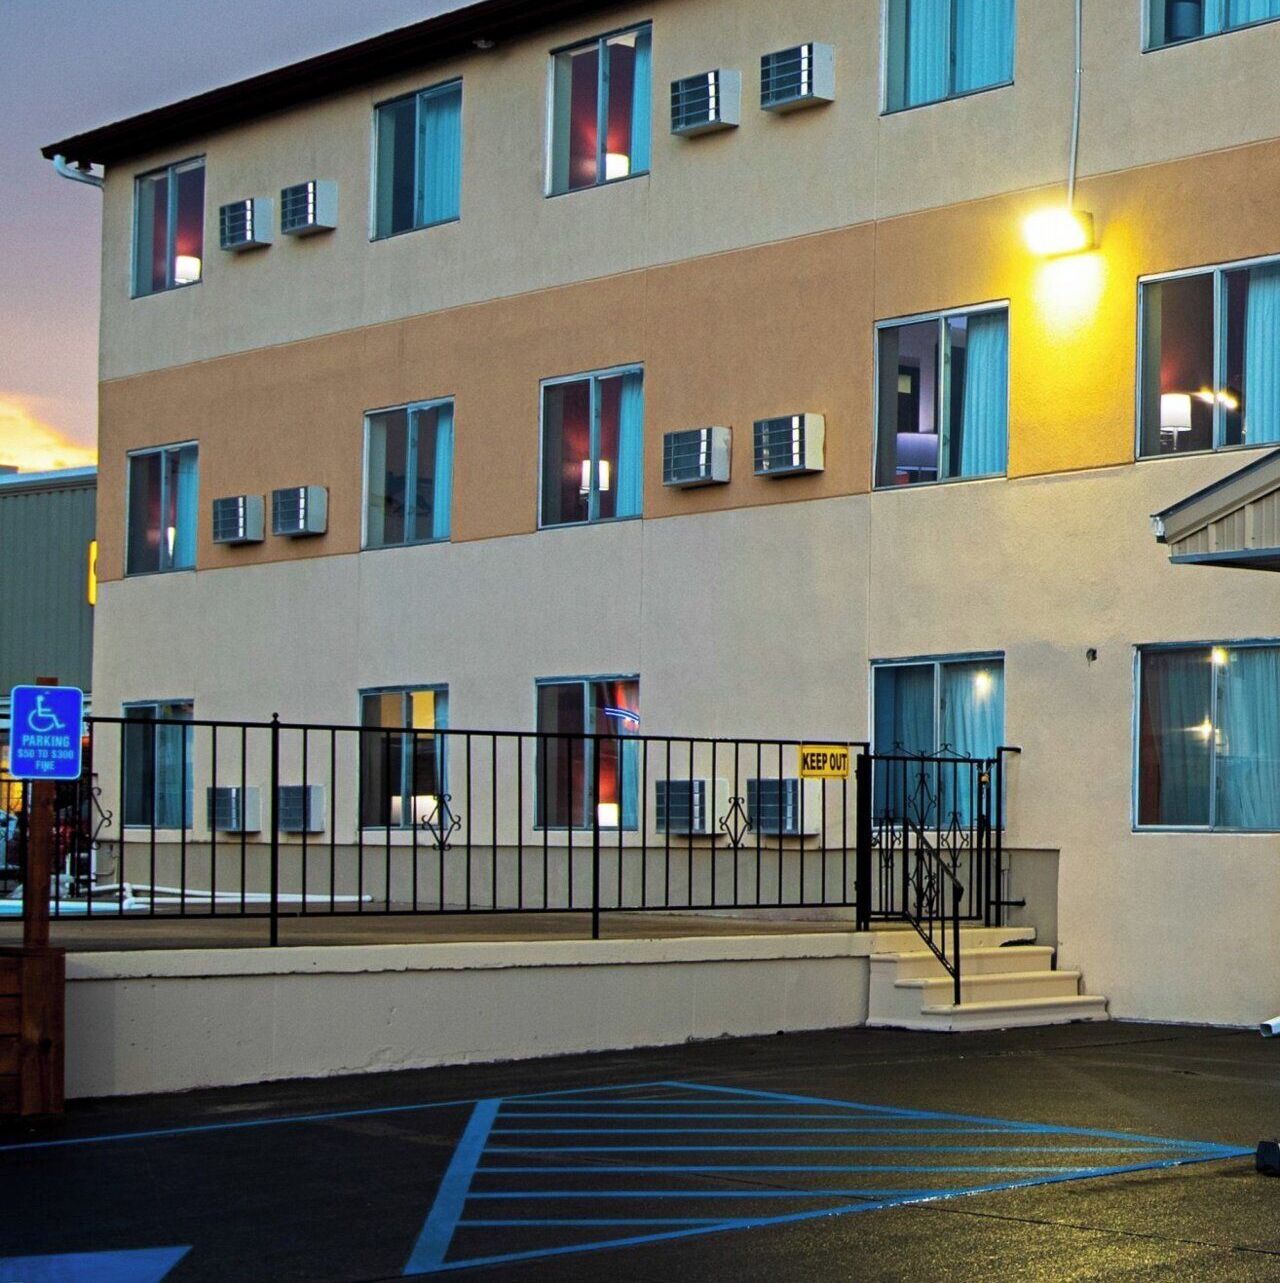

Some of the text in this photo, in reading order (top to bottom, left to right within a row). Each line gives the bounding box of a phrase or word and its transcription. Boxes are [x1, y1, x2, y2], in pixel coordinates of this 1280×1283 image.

[22, 734, 70, 747] PARKING
[38, 748, 49, 758] TO
[35, 760, 56, 771] FINE
[802, 753, 848, 771] KEEP OUT
